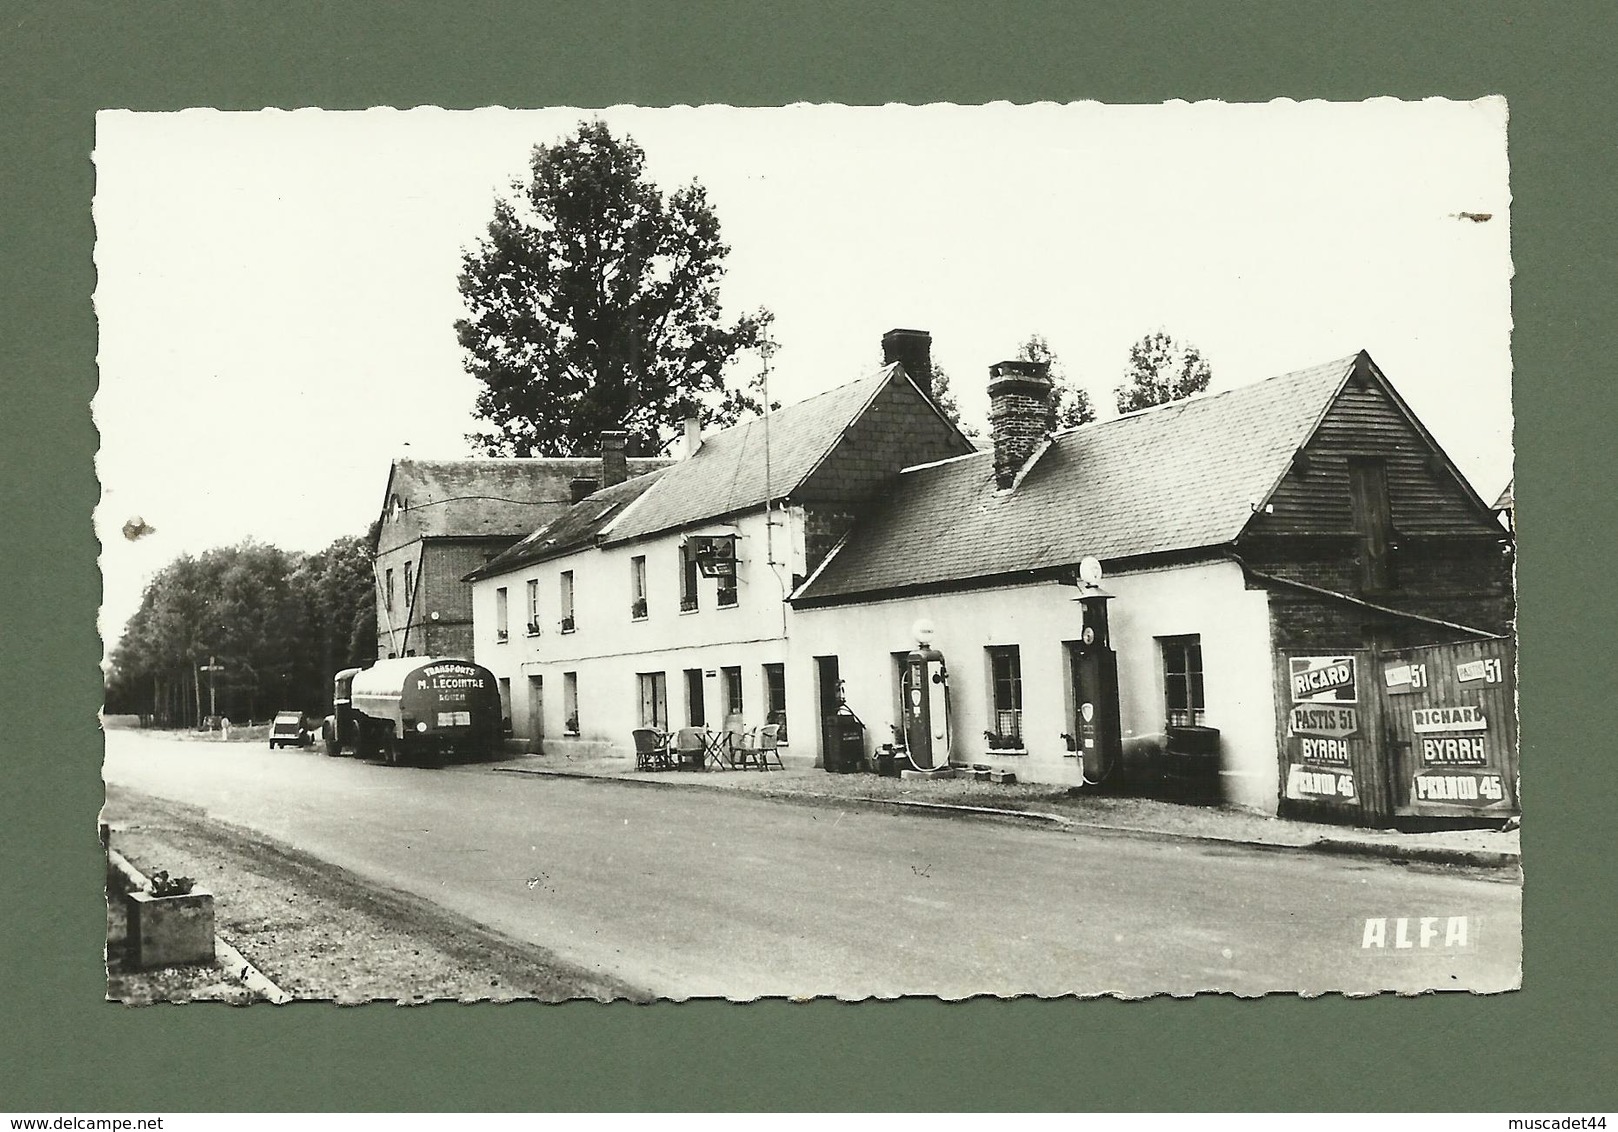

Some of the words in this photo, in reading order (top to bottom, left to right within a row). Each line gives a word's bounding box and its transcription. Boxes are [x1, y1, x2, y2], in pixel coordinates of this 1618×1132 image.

[423, 664, 476, 677] TRANSPORTS
[1294, 665, 1350, 693] RICARD
[1410, 664, 1428, 688] 51
[1484, 659, 1502, 683] 51
[417, 679, 430, 690] M.
[433, 678, 484, 689] LECOINTRE
[1295, 710, 1336, 730] PASTIS
[1339, 710, 1354, 730] 51
[1302, 738, 1348, 760] BYRRH
[1423, 738, 1485, 760] BYRRH
[1480, 776, 1502, 800] 45
